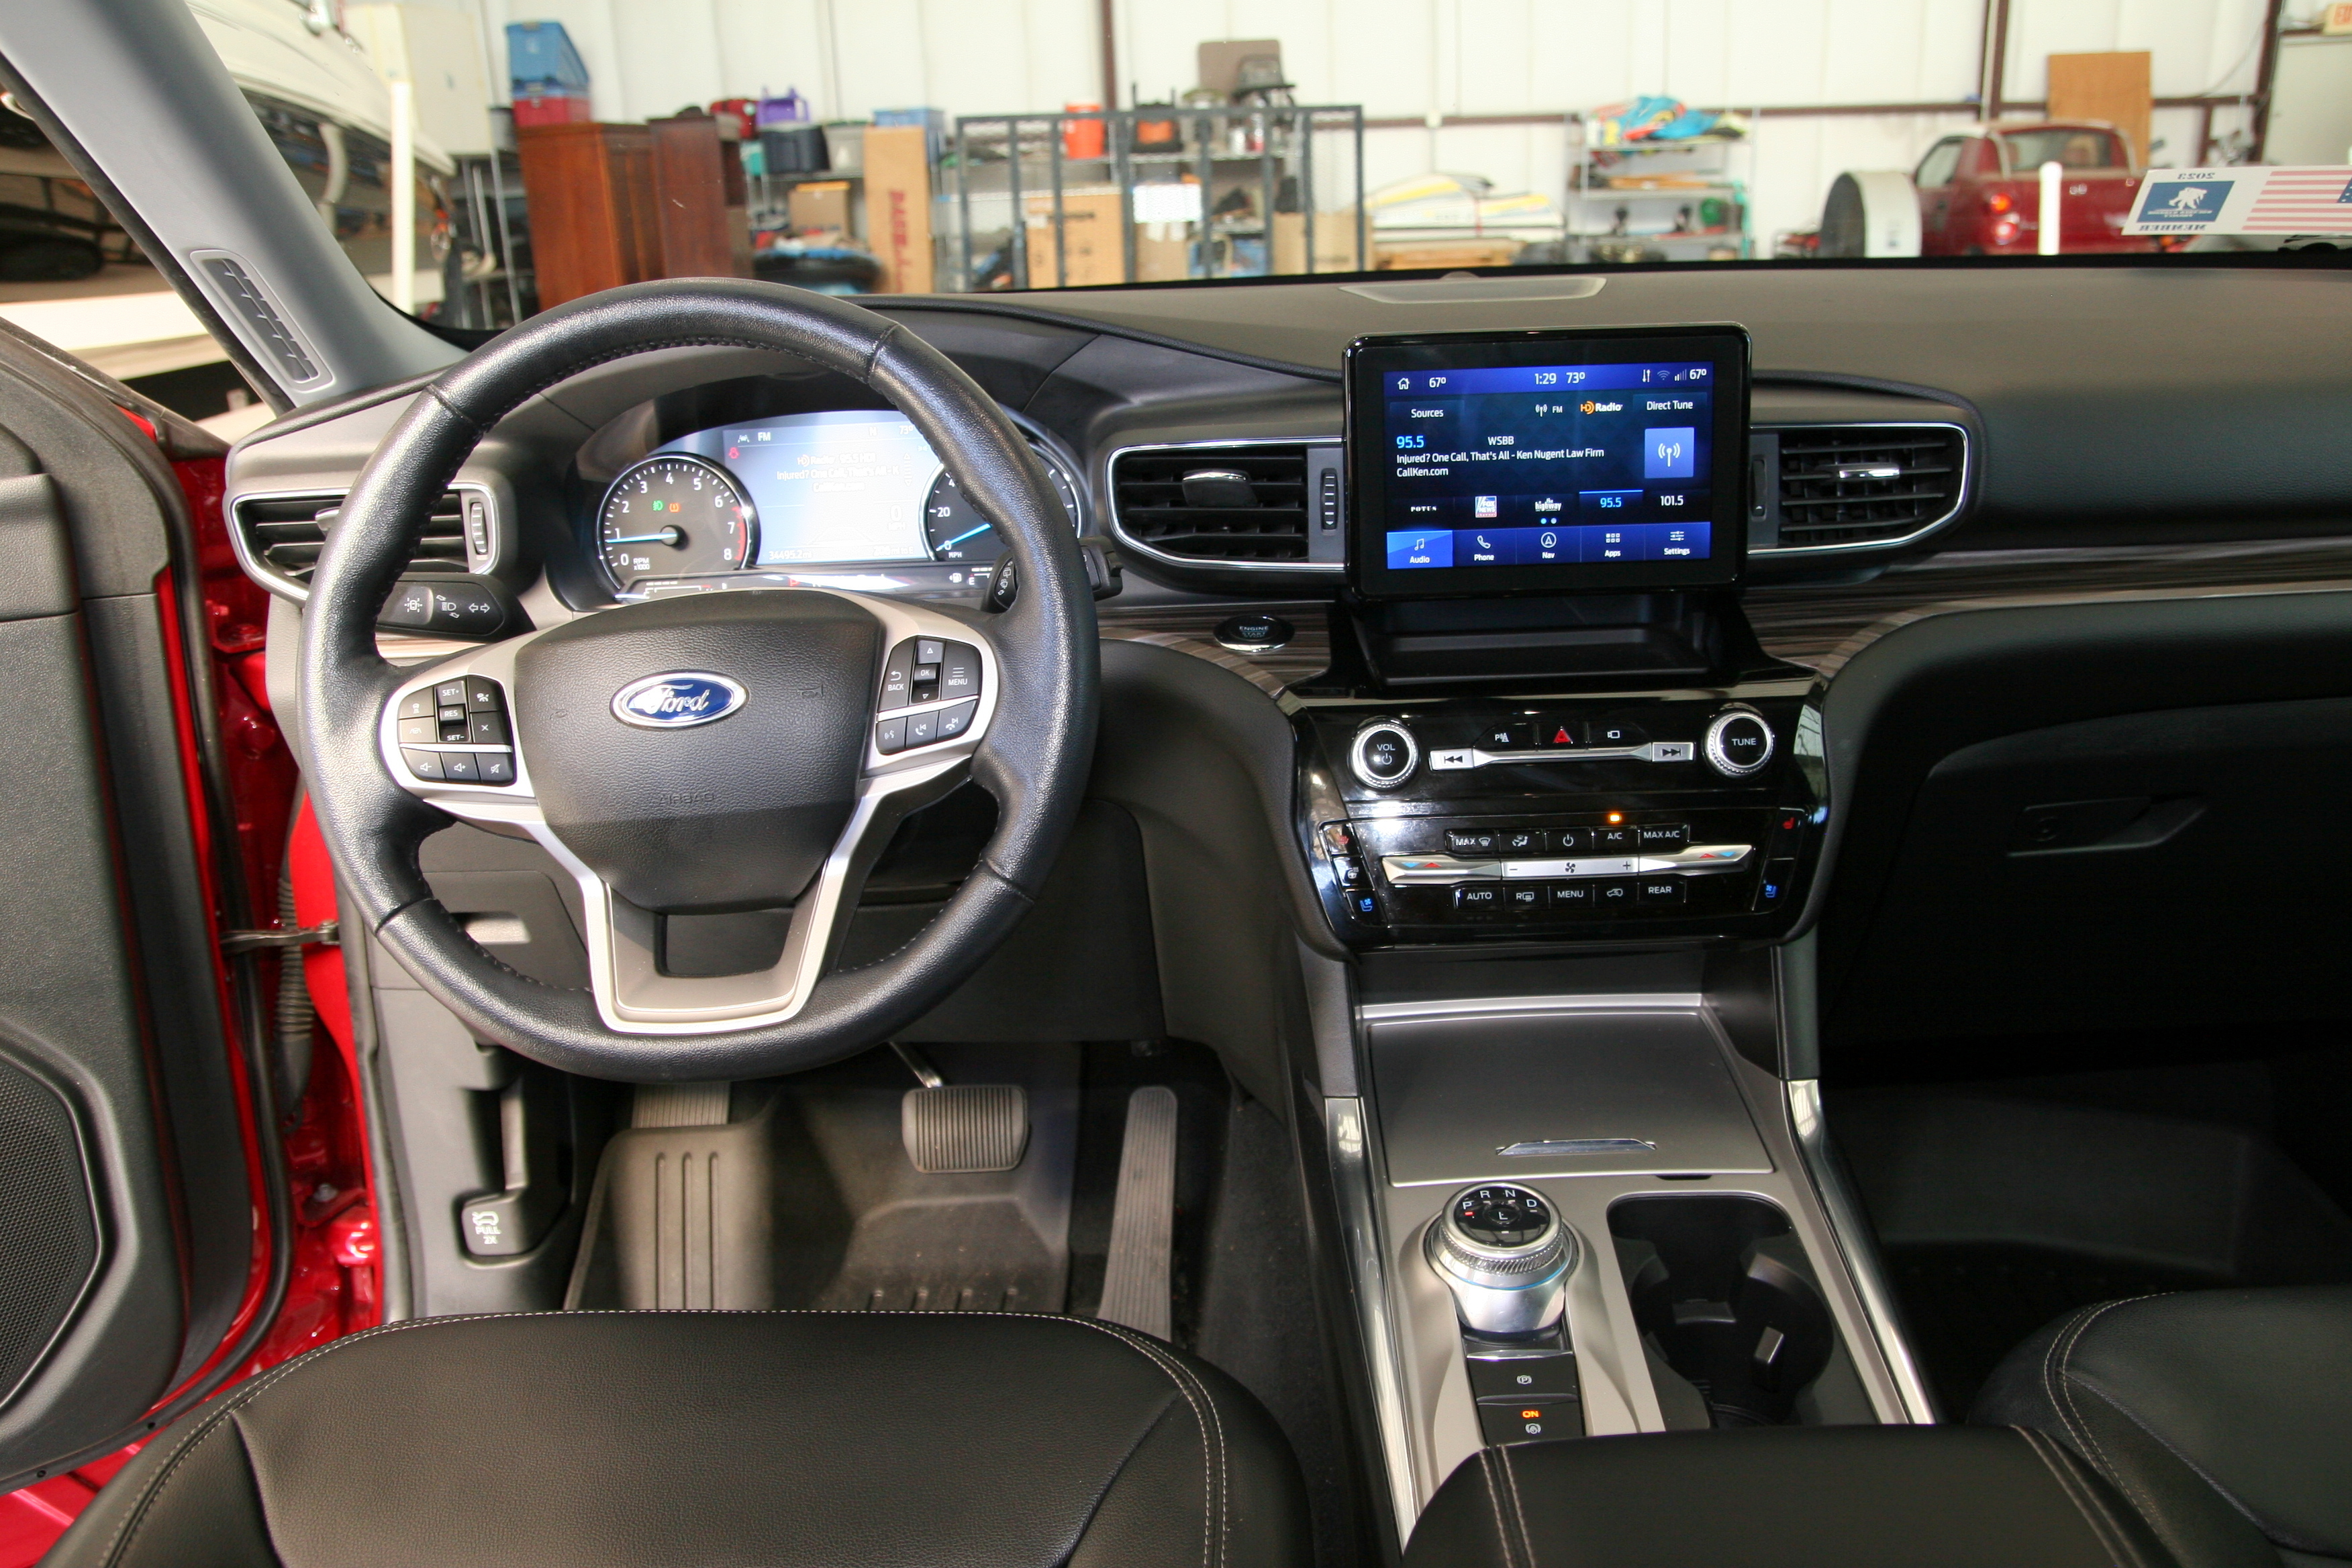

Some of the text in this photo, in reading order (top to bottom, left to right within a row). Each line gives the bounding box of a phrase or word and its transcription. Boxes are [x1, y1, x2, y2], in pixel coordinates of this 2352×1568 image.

[1534, 373, 1557, 385] 1:29
[1552, 405, 1563, 414] FM
[1595, 402, 1622, 412] Radio
[1647, 400, 1694, 411] Direct Tune
[1411, 408, 1444, 418] Sources
[757, 432, 771, 442] FM
[1487, 436, 1514, 446] WSBB
[1396, 436, 1424, 449] 95.5
[1396, 453, 1430, 465] Injured?
[1432, 453, 1449, 463] One
[1450, 452, 1469, 462] Call,
[1470, 451, 1497, 461] That's
[1498, 450, 1510, 460] All
[1516, 450, 1533, 460] Ken
[1534, 450, 1565, 460] Nugent
[1566, 449, 1583, 458] Law
[1585, 448, 1604, 458] Firm
[1396, 467, 1449, 477] CallKen.com
[665, 472, 674, 485] 4
[640, 480, 648, 493] 3
[693, 477, 702, 491] 5
[714, 495, 724, 508] 6
[1600, 497, 1622, 508] 95.5
[1660, 495, 1684, 506] 101.5
[622, 500, 630, 513] 2
[937, 507, 950, 518] 20
[728, 522, 735, 534] 7
[614, 528, 620, 540] 1
[724, 548, 732, 560] 8
[1604, 550, 1621, 558] Apps
[1663, 547, 1690, 556] Settings
[620, 553, 629, 566] 0
[1410, 555, 1430, 564] Audio
[1474, 553, 1495, 561] Phone
[969, 577, 975, 585] E
[948, 678, 968, 686] MENU
[887, 683, 904, 691] BACK
[639, 683, 711, 715] Ford
[444, 709, 458, 718] RES
[1731, 738, 1757, 746] TUNE
[1376, 743, 1396, 752] VOL
[1607, 832, 1622, 840] A/C
[1643, 830, 1680, 839] MAX A/C
[1455, 838, 1476, 846] MAX
[1557, 890, 1584, 899] MENU
[1648, 886, 1672, 895] REAR
[1466, 891, 1493, 901] AUTO
[1479, 1189, 1491, 1198] R
[1504, 1189, 1516, 1197] N
[1462, 1201, 1473, 1210] P
[1526, 1199, 1538, 1208] D
[1498, 1212, 1508, 1220] L
[475, 1226, 502, 1235] PULL
[483, 1235, 497, 1244] 2X
[1522, 1410, 1539, 1418] ON
